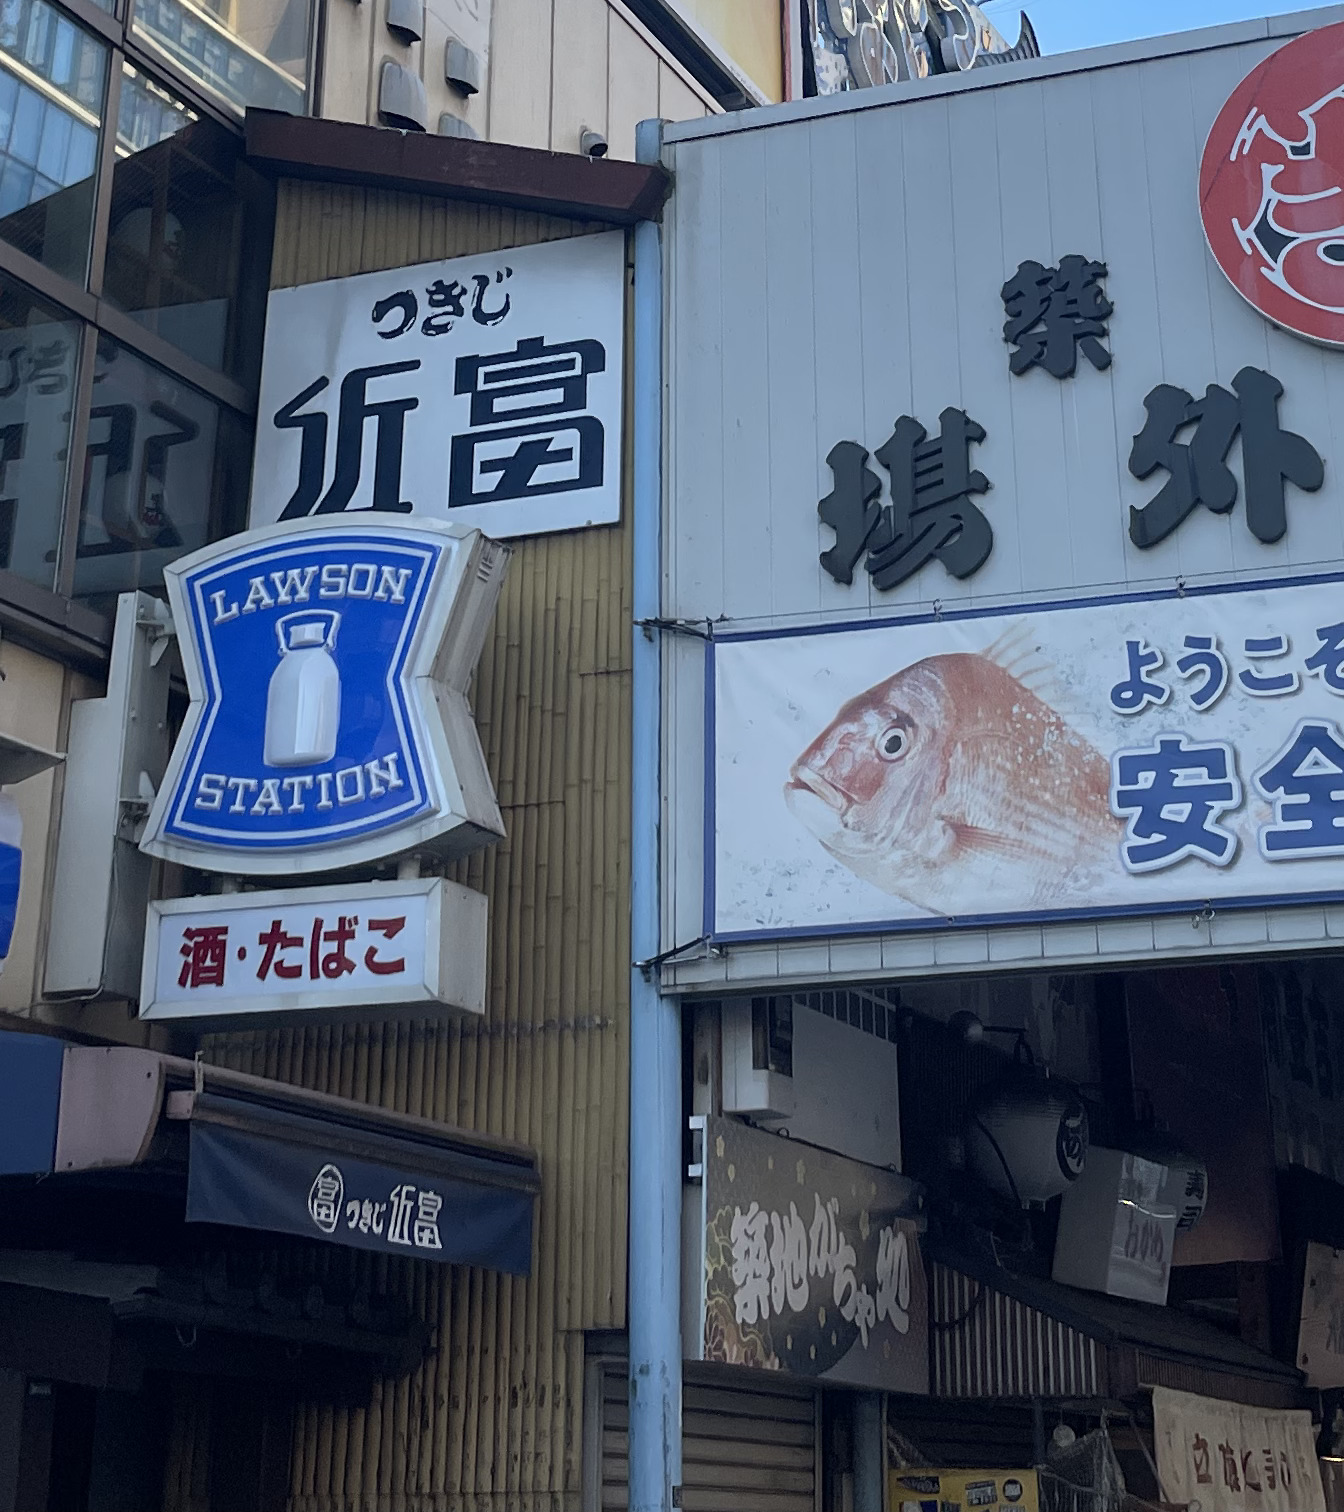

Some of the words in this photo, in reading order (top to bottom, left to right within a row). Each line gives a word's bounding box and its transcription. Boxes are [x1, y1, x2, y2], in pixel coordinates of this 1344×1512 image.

[370, 266, 514, 341] つきじ
[273, 334, 607, 522] 近富
[208, 562, 415, 626] LAWSON
[193, 752, 405, 817] STATION
[177, 915, 409, 991] 酒・たばこ
[387, 1183, 444, 1250] 近富
